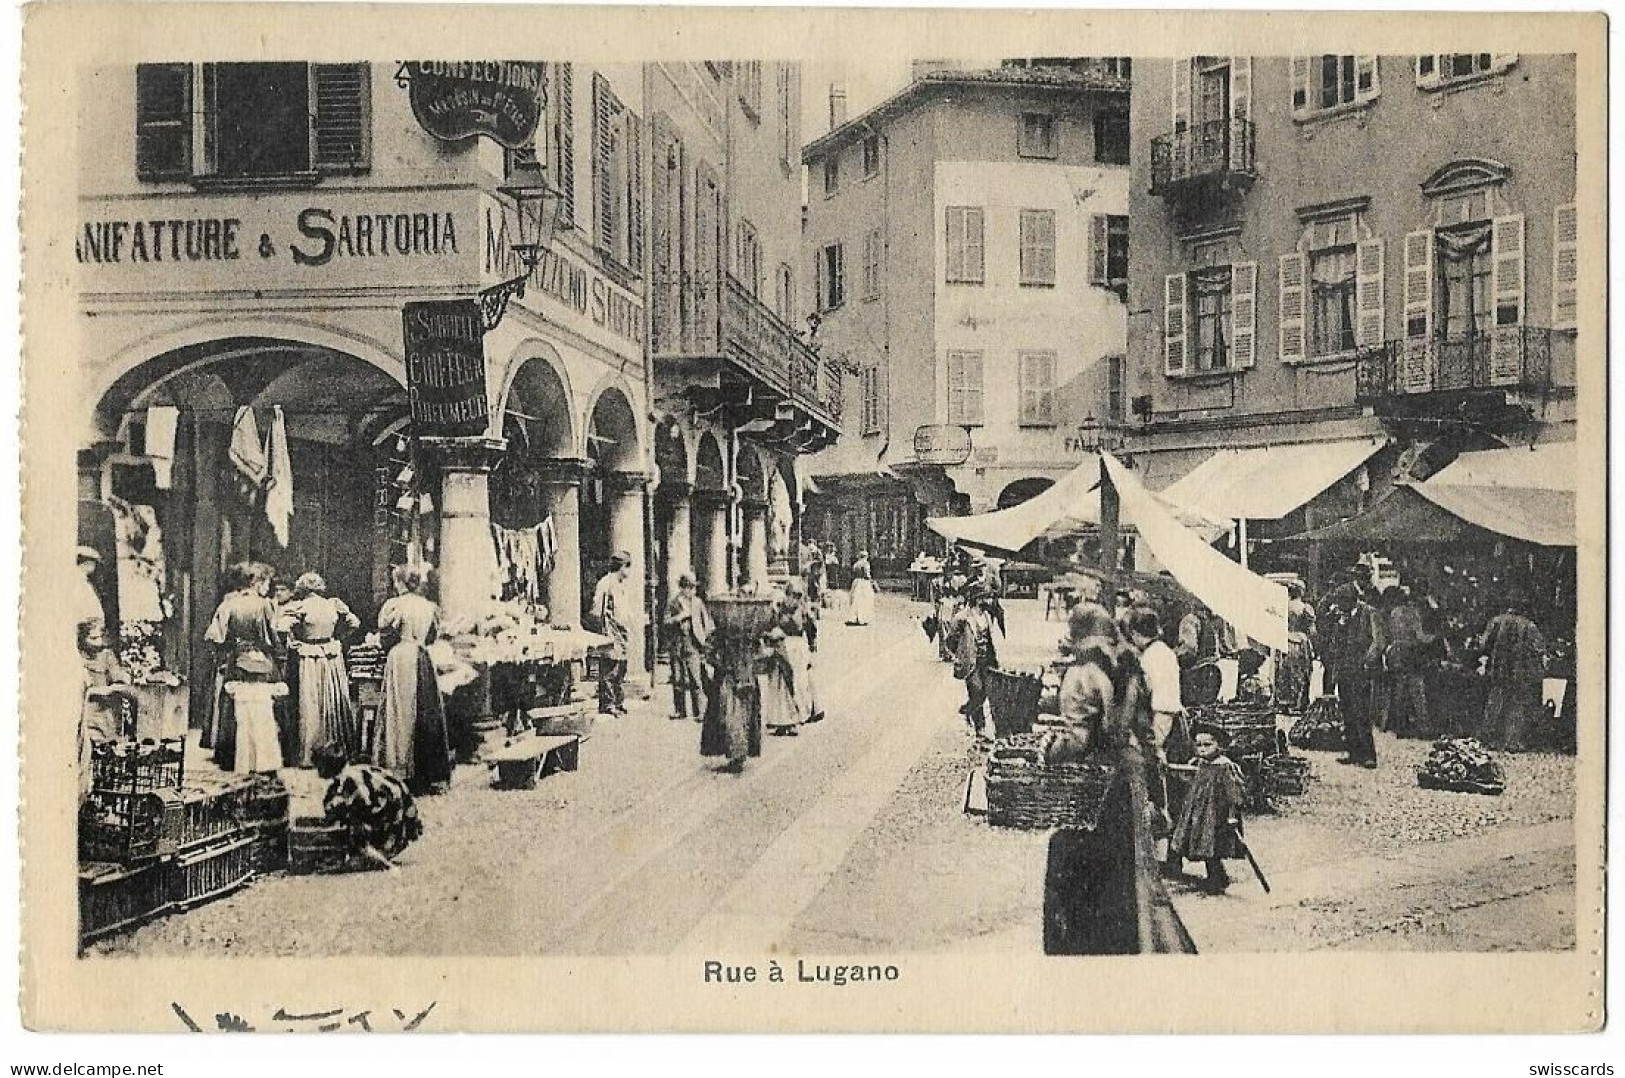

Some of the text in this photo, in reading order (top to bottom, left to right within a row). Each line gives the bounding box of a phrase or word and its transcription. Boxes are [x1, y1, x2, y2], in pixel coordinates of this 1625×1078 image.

[419, 61, 538, 89] CONFECTIONS
[259, 233, 276, 258] &
[290, 208, 459, 266] SARTORIA
[1065, 438, 1125, 453] FARICA
